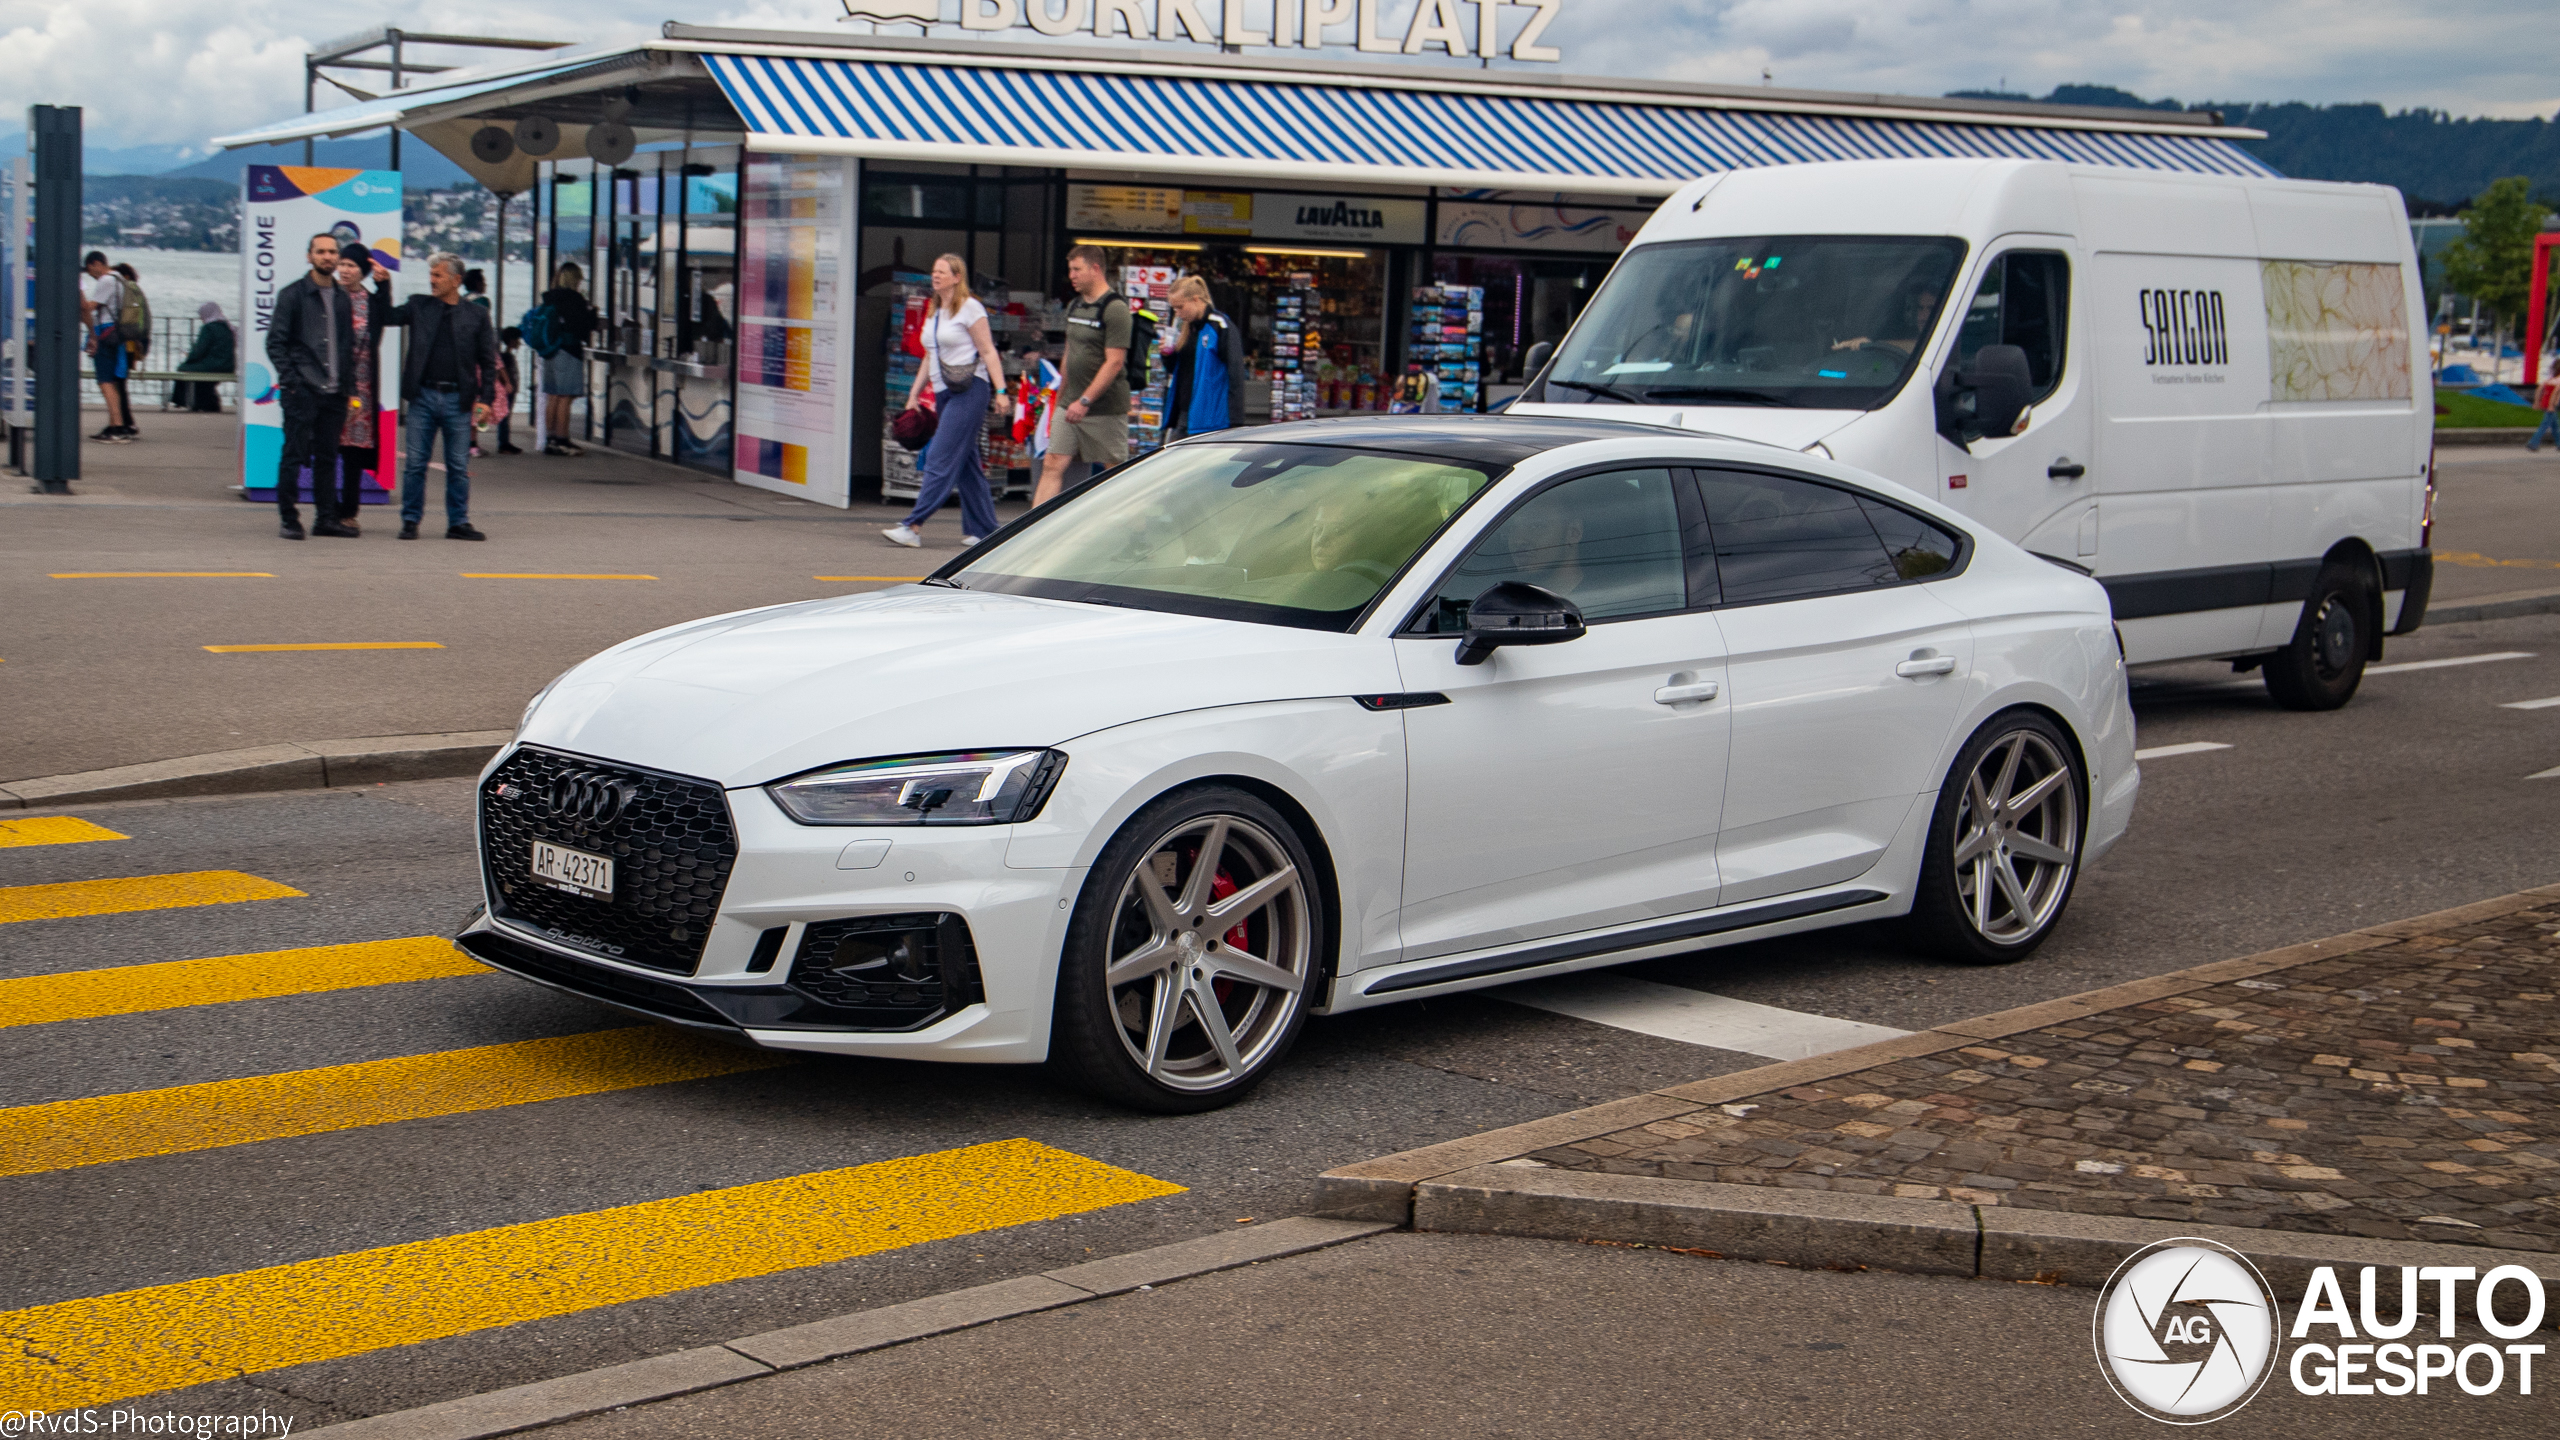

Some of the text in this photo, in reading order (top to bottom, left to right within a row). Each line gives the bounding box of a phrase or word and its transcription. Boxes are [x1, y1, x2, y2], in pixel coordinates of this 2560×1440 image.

[1296, 201, 1383, 229] LAVAZZA
[256, 215, 275, 332] WELCOME
[2140, 288, 2228, 365] SAIGON
[547, 927, 625, 955] quattro
